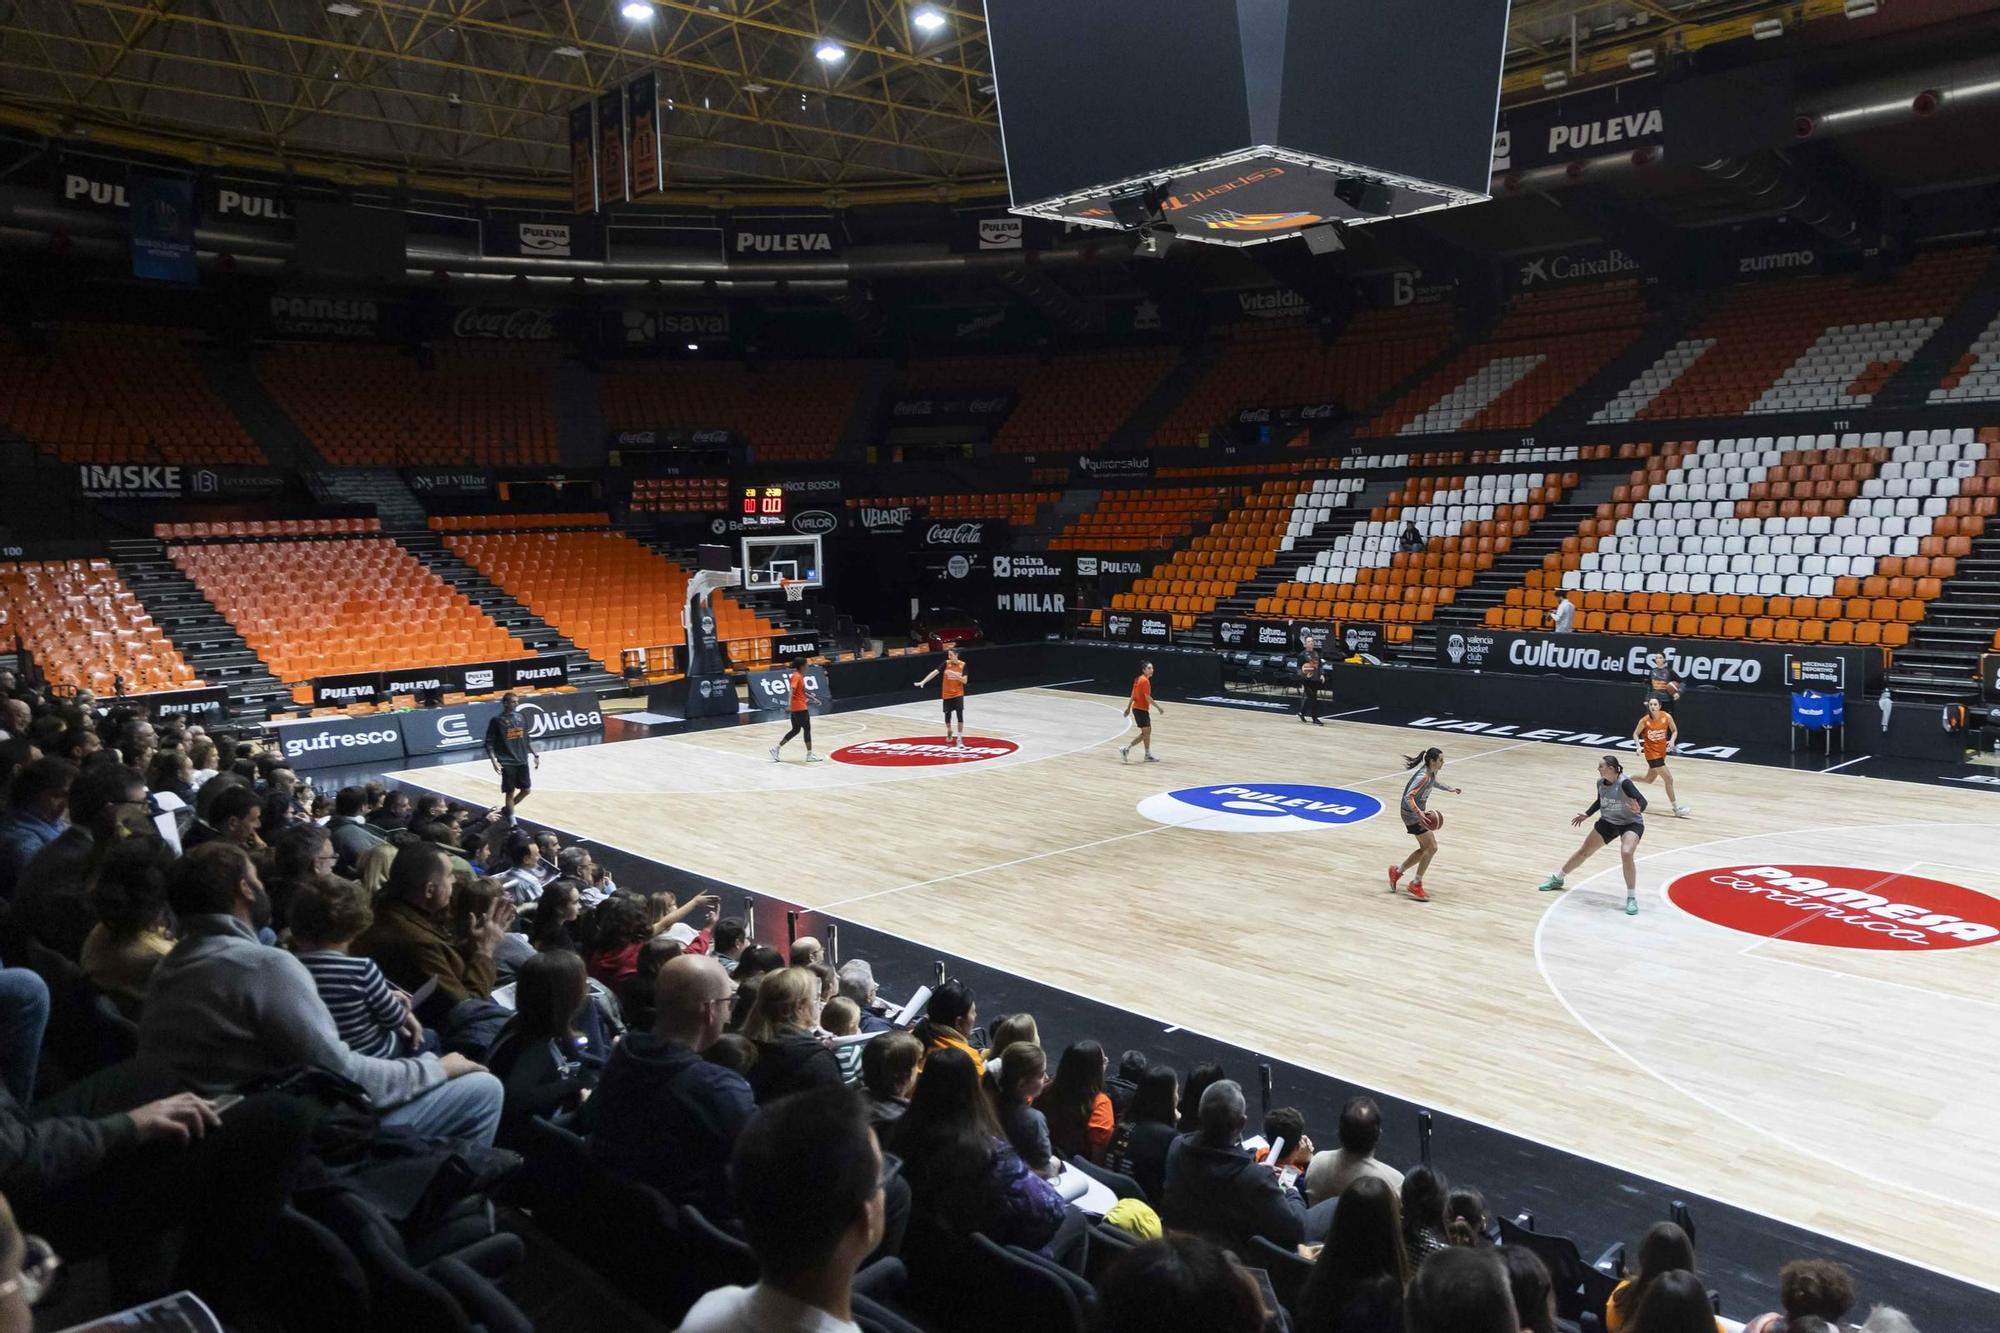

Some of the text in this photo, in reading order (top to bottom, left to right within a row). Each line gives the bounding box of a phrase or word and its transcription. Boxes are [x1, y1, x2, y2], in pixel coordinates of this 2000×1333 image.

[1548, 109, 1663, 154] PULEVA
[522, 227, 567, 239] PULEVA
[981, 221, 1021, 234] PULEVA
[736, 232, 832, 253] PULEVA
[1550, 248, 1640, 280] CaixaBa
[1739, 250, 1815, 274] zummo
[658, 310, 730, 335] isaval
[1833, 421, 1850, 430] 111
[1521, 437, 1535, 446] 112
[80, 465, 182, 489] IMSKE
[807, 481, 840, 490] BOSCH
[797, 518, 832, 529] VALOR
[861, 507, 912, 528] VELARTE
[3, 546, 23, 556] 100
[1012, 555, 1044, 567] caixa
[1101, 560, 1142, 574] PULEVA
[1013, 565, 1062, 579] popular
[1014, 593, 1065, 613] MILAR
[1467, 636, 1494, 645] valencia
[778, 643, 815, 655] PULEVA
[1467, 645, 1489, 654] basket
[1508, 638, 1601, 671] Cultura
[1600, 656, 1625, 672] del
[1466, 653, 1483, 662] club
[516, 667, 562, 681] PULEVA
[1802, 672, 1838, 683] Juan Roig
[320, 685, 375, 700] PULEVA
[390, 679, 440, 694] PULEVA
[530, 709, 603, 738] Midea
[285, 729, 398, 757] gufresco
[1209, 786, 1358, 816] PULEVA
[1732, 866, 2000, 942] PAMESA
